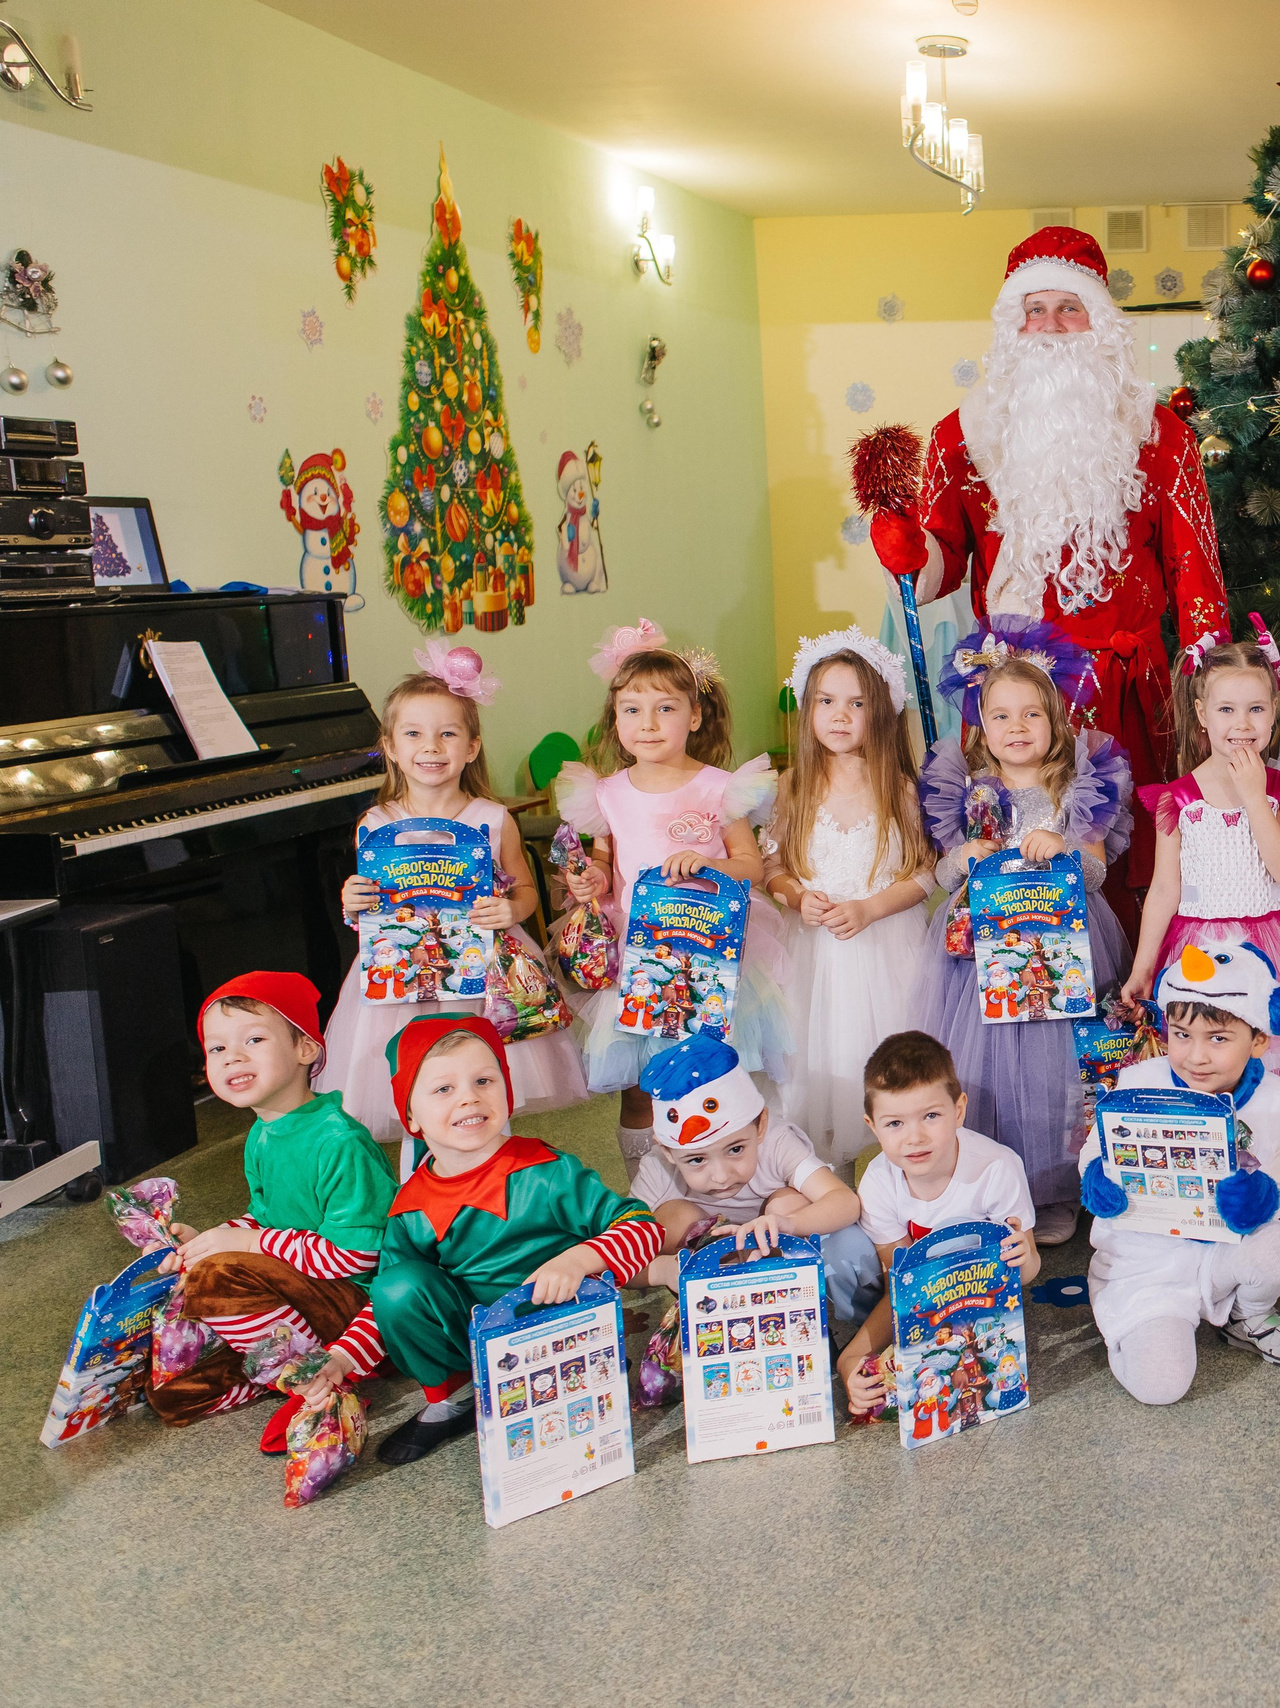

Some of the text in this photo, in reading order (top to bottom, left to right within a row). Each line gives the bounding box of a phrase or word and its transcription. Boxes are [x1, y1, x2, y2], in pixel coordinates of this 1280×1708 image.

[382, 859, 468, 878] НОВОГОДНИЙ
[394, 874, 457, 890] ПОДАРОК
[990, 886, 1063, 906] НОВОГОДНИЙ
[651, 901, 724, 925] НОВОГОДНИЙ
[1001, 900, 1054, 916] ПОДАРОК
[658, 916, 712, 934] ПОДАРОК
[980, 928, 990, 937] 18
[634, 934, 643, 943] 18
[1093, 1038, 1133, 1053] НОВОГО
[921, 1262, 998, 1300] НОВОГОДНИЙ
[932, 1280, 988, 1309] ПОДАРОК
[939, 1310, 946, 1318] ОТ
[948, 1302, 963, 1313] ДЕДА
[910, 1328, 920, 1341] 18
[89, 1354, 102, 1366] 18
